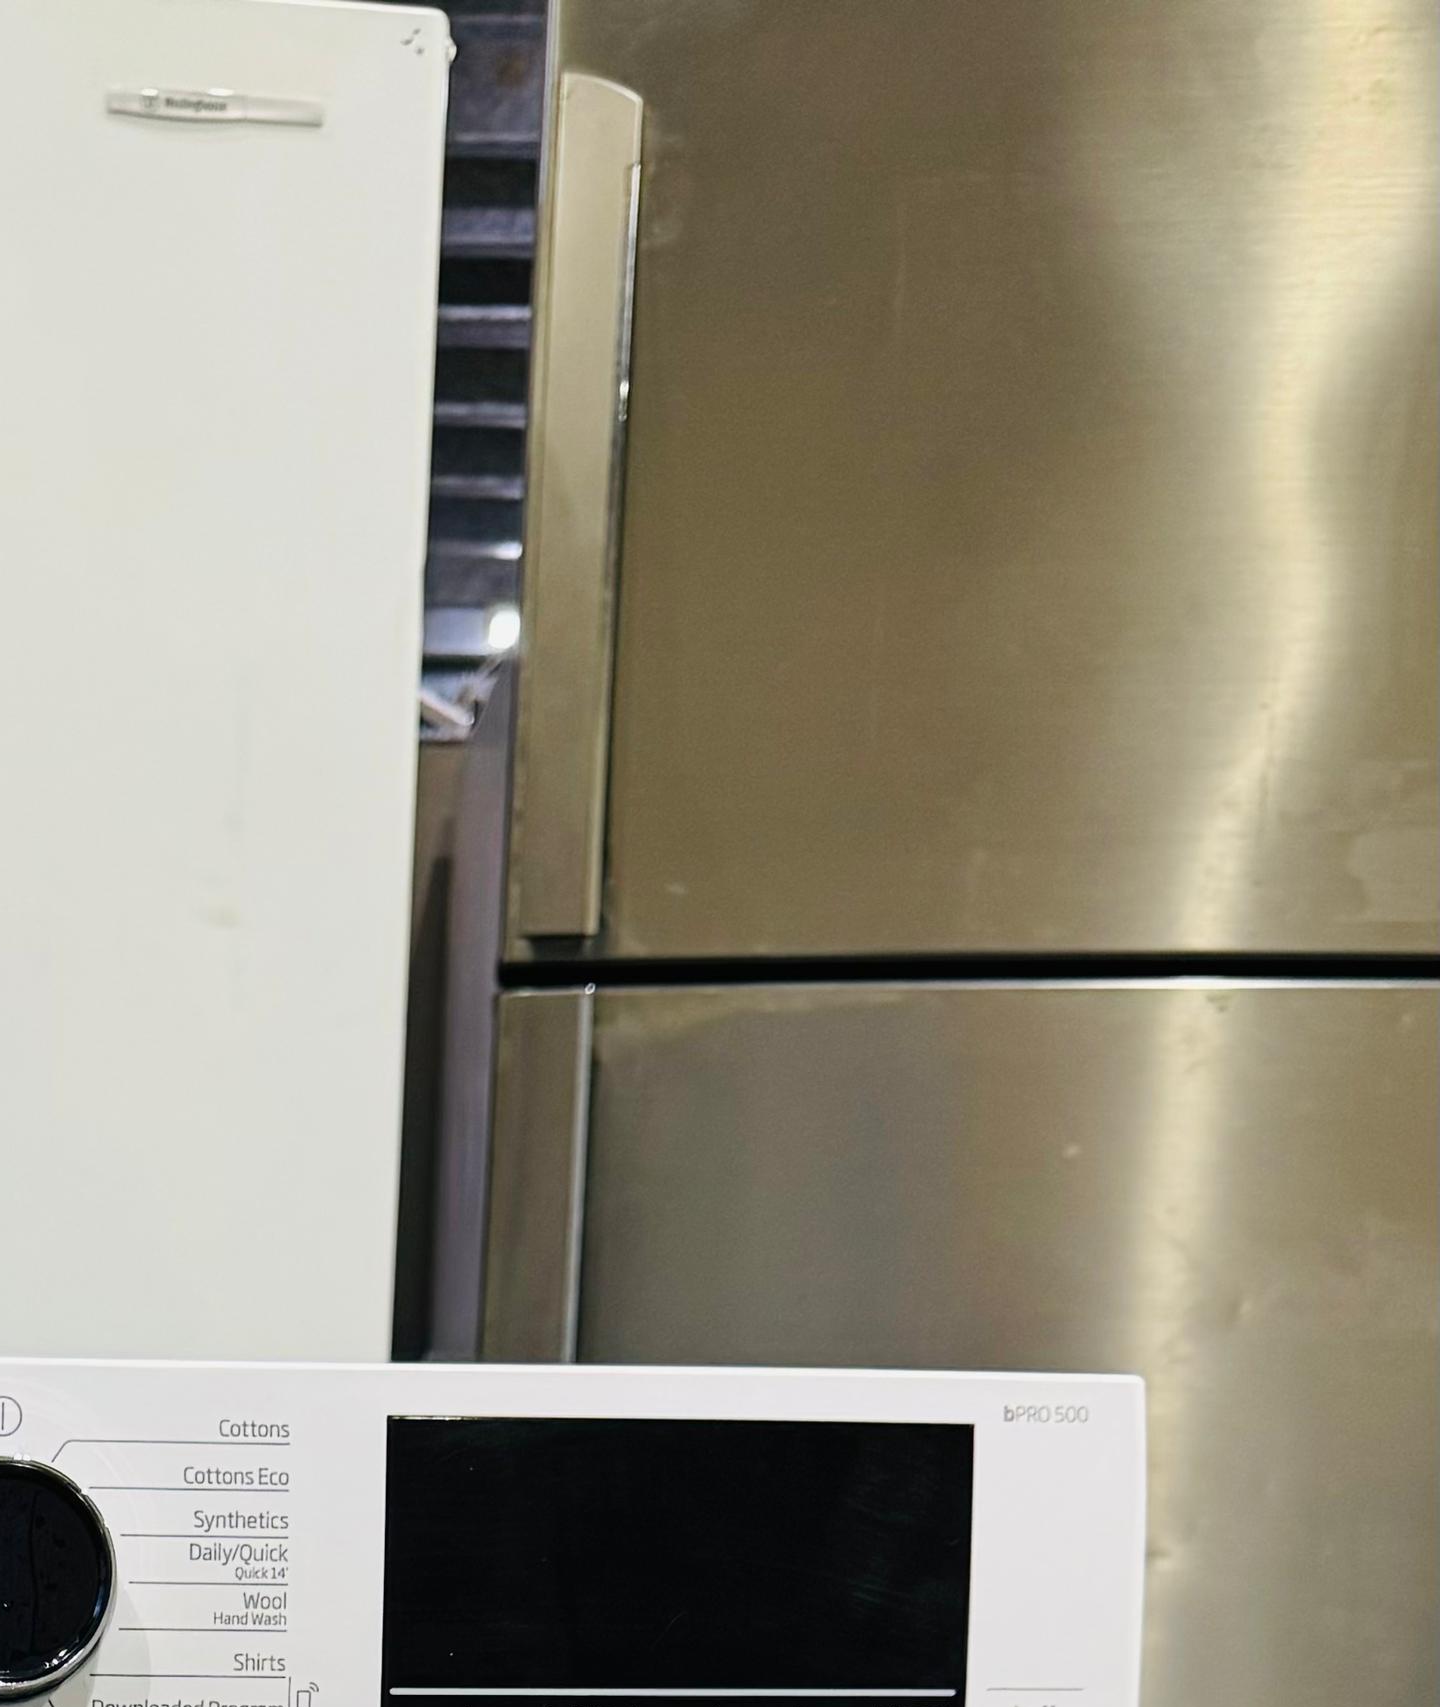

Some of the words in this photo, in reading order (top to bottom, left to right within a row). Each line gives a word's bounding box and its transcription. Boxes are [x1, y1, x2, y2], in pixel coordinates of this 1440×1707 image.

[1003, 1405, 1050, 1423] bPRO
[1054, 1405, 1089, 1423] 500
[219, 1419, 290, 1438] Cottons
[183, 1466, 254, 1485] Cottons
[258, 1467, 289, 1486] Eco
[193, 1510, 289, 1532] Synthetics
[189, 1543, 288, 1565] Daily/Quick
[235, 1567, 268, 1580] Quick
[243, 1592, 287, 1610] Wool
[213, 1612, 249, 1626] Hand
[251, 1612, 287, 1626] Wash
[233, 1653, 286, 1672] Shirts
